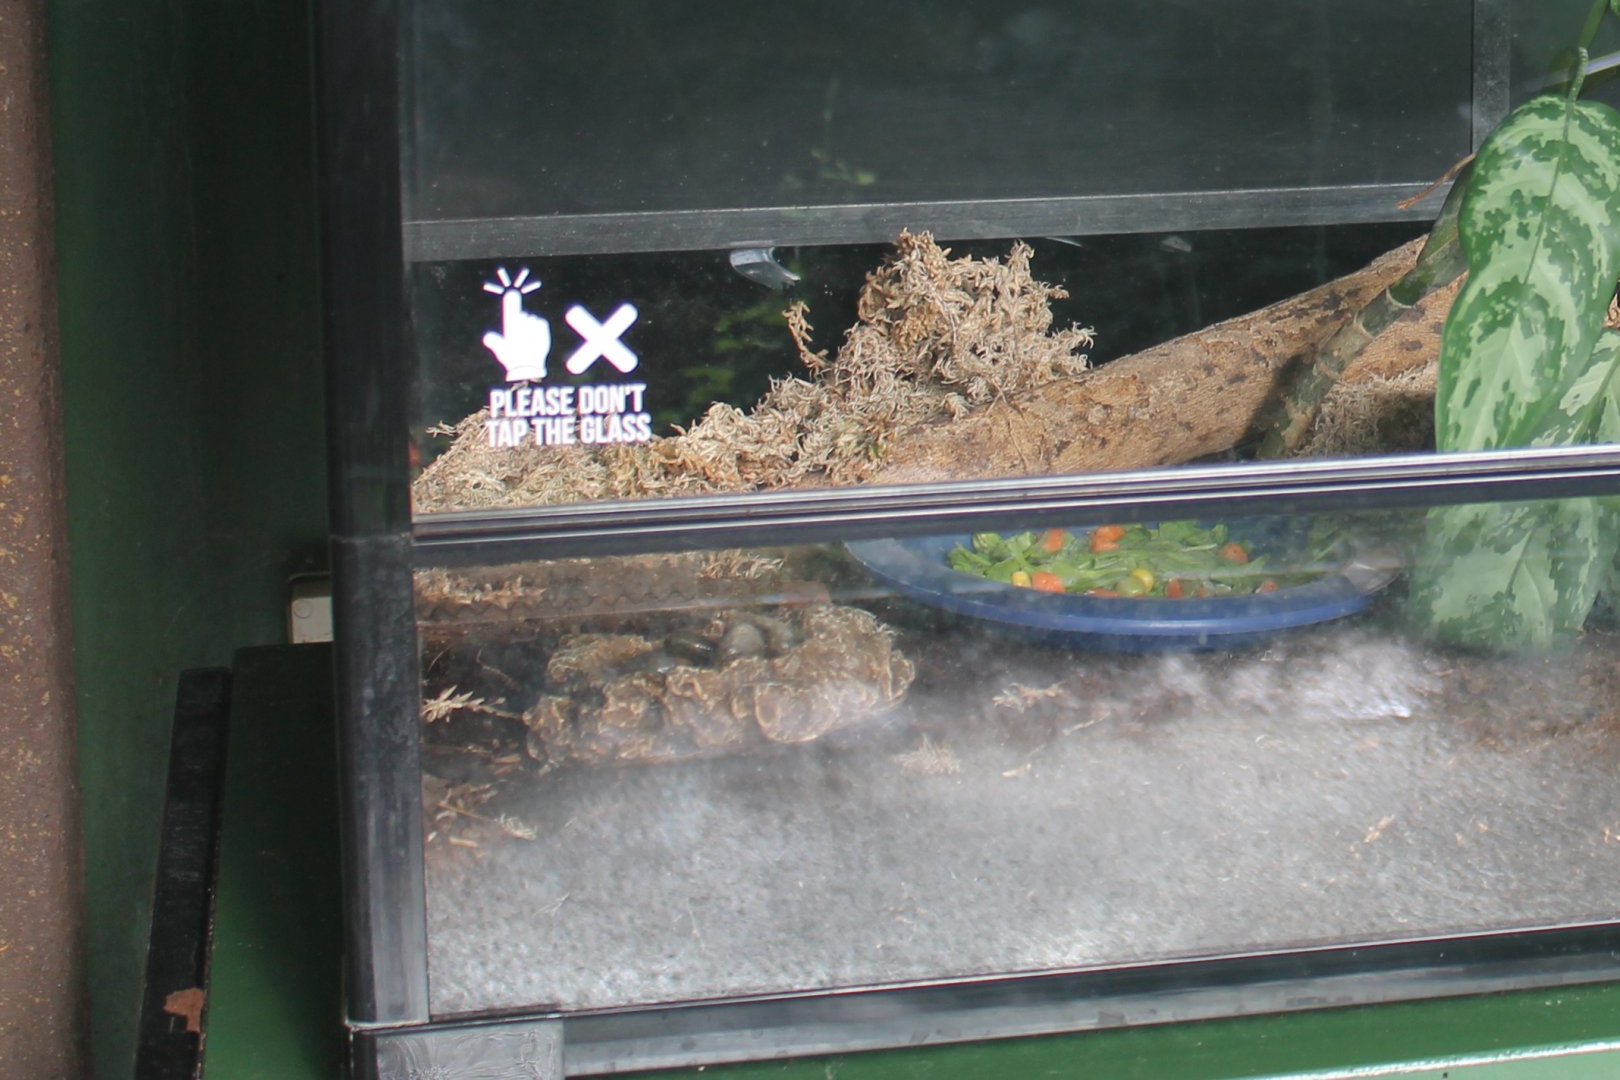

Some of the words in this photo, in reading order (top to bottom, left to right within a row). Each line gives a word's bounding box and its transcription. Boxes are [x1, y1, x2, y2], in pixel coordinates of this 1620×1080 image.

[490, 386, 575, 418] PLEASE
[578, 383, 647, 414] DON'T
[486, 419, 527, 447] TAP
[531, 416, 575, 446] THE
[580, 413, 652, 444] GLASS
